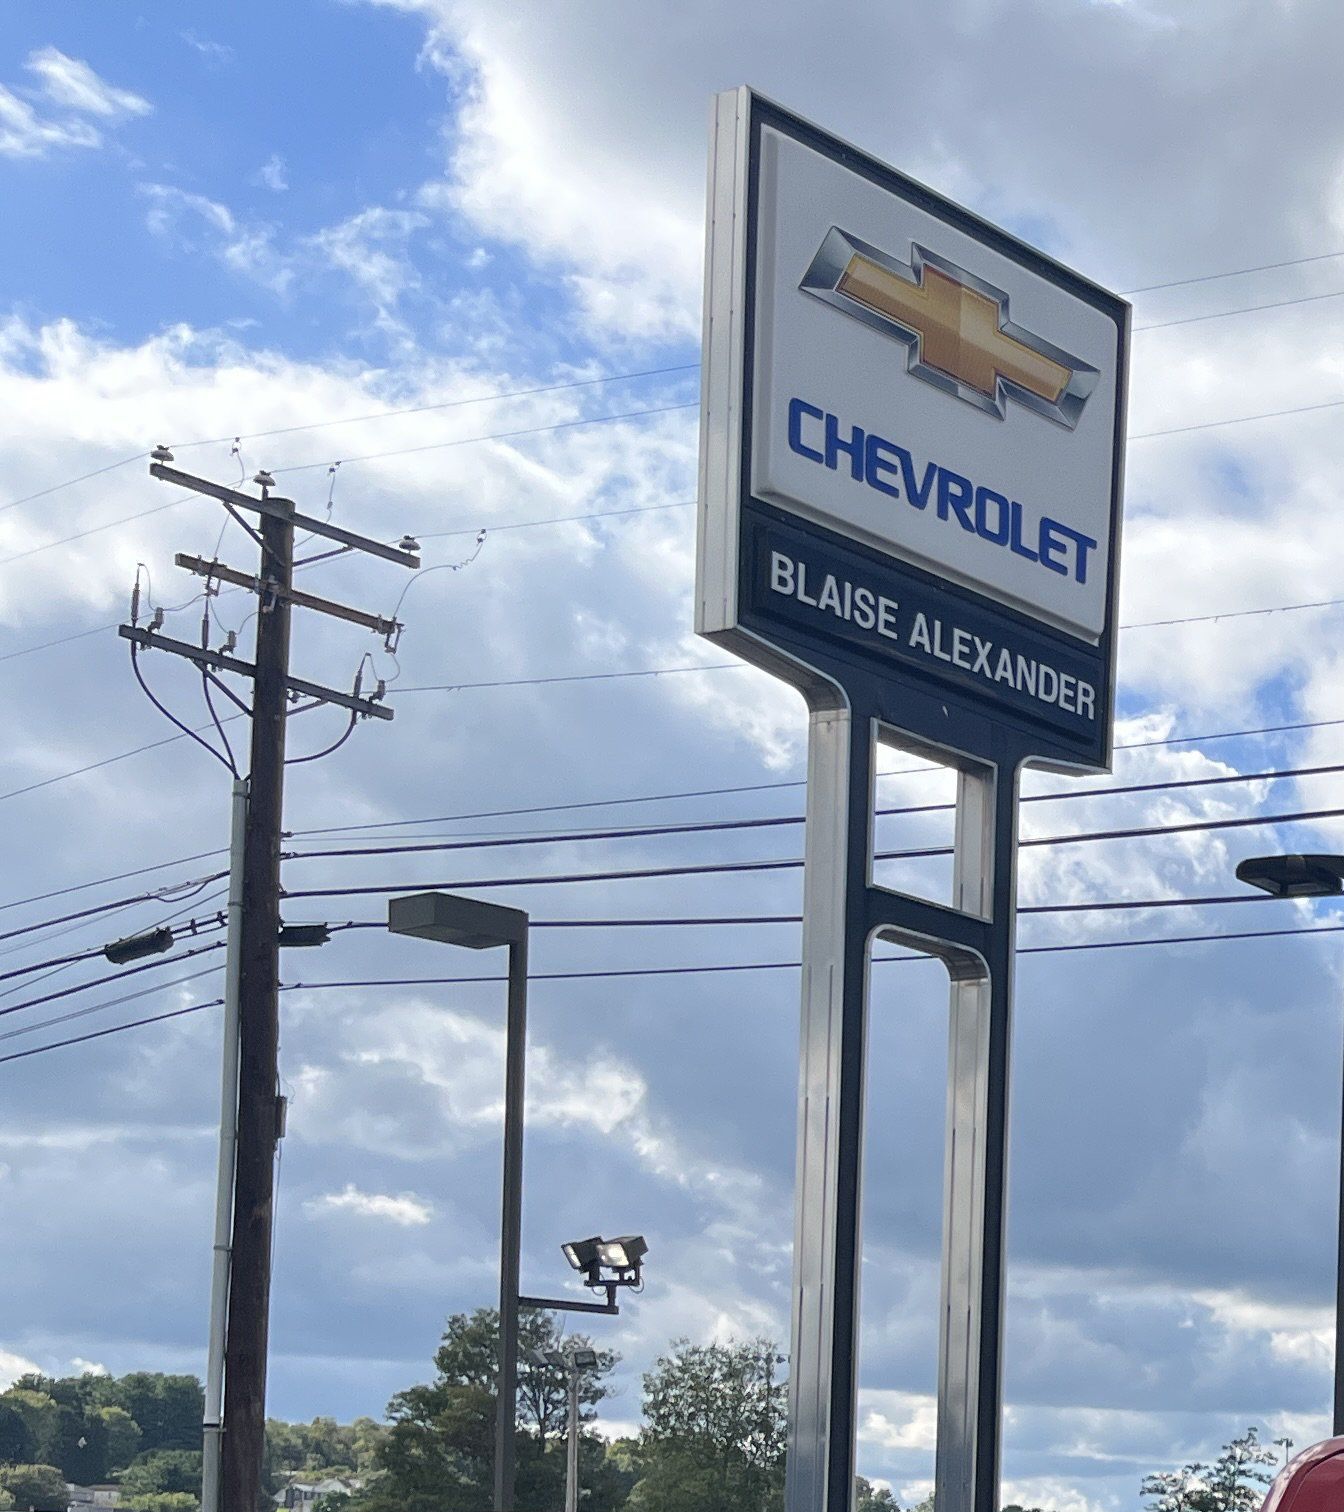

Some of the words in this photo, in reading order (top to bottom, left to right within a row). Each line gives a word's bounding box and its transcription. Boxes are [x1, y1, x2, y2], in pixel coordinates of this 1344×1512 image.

[788, 397, 1097, 585] CHEVROLET
[771, 550, 899, 640] BLAISE
[908, 612, 1096, 721] ALEXANDER
